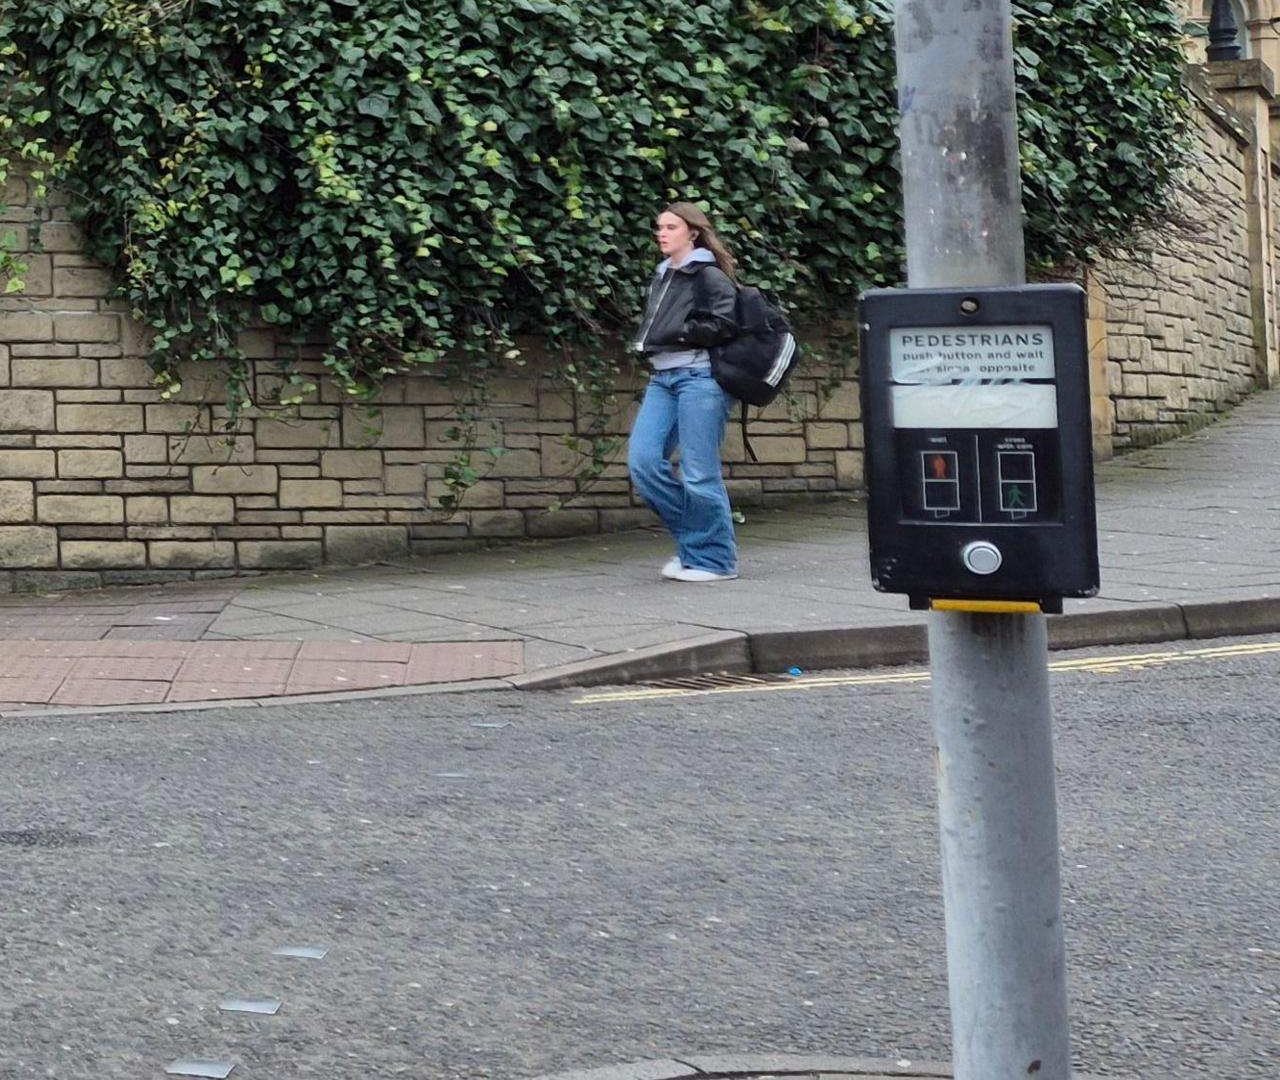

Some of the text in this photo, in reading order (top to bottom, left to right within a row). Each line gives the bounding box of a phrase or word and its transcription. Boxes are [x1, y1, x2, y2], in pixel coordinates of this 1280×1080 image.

[902, 332, 1044, 348] PEDESTRIANS
[903, 351, 933, 361] push
[988, 350, 1011, 360] and
[1016, 350, 1044, 360] wait
[979, 363, 1036, 374] opposite
